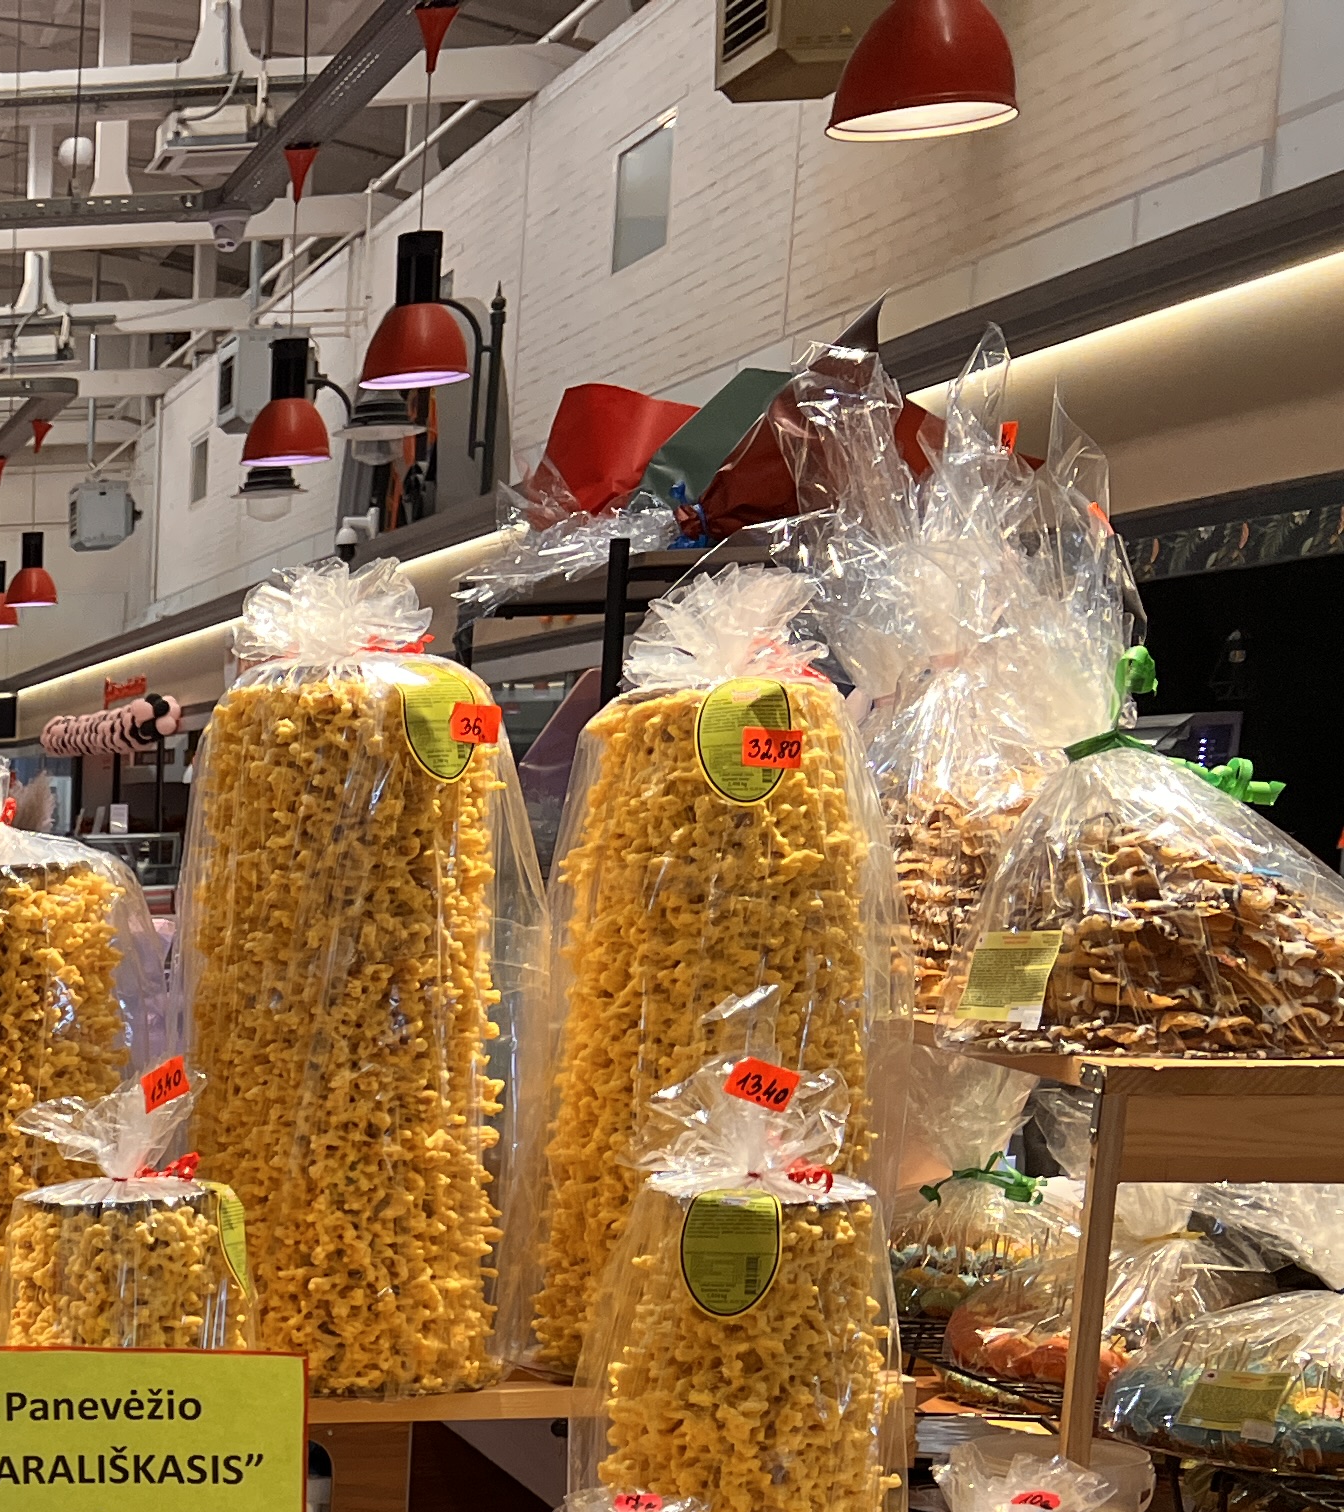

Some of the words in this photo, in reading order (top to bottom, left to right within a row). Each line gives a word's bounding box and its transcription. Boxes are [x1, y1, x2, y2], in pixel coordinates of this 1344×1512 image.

[746, 738, 800, 763] 32,80
[736, 1072, 789, 1104] 13.40
[5, 1388, 203, 1422] Panevėžio
